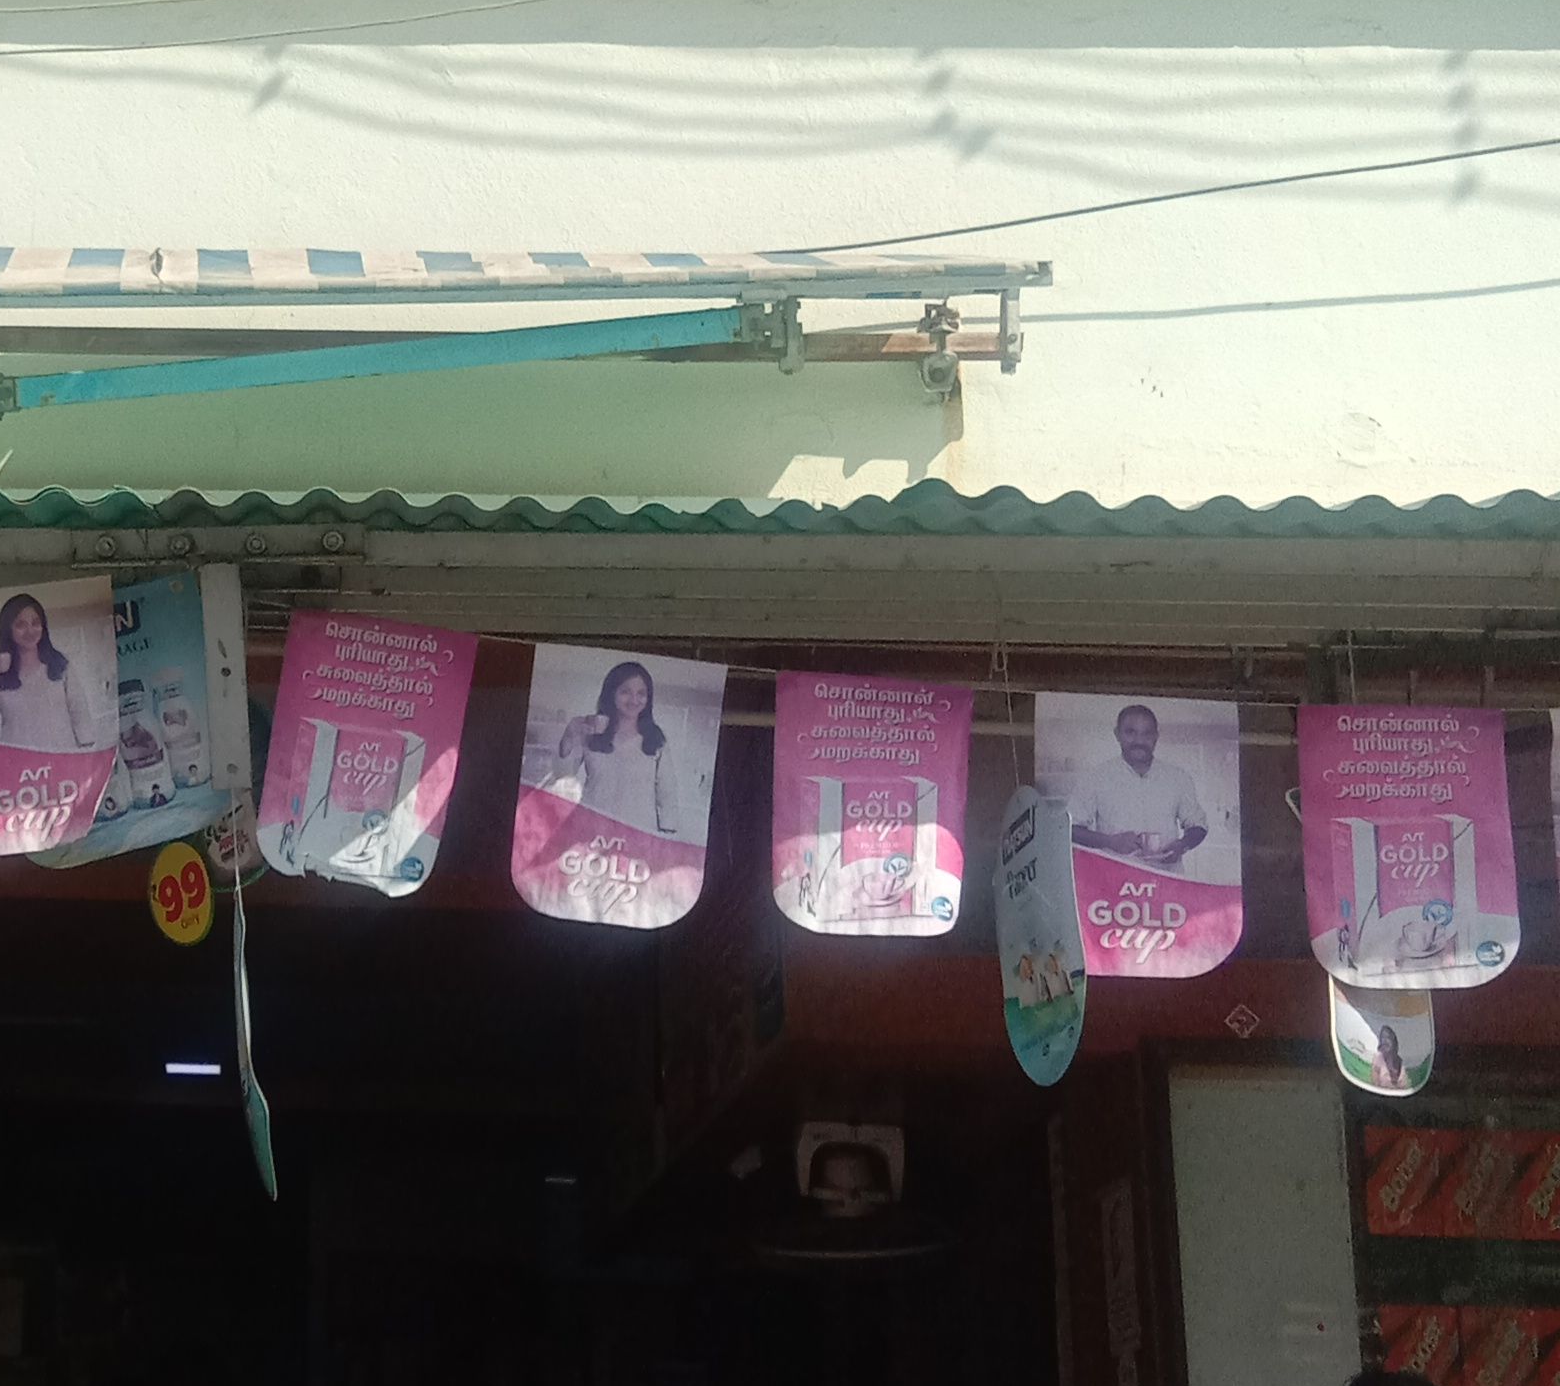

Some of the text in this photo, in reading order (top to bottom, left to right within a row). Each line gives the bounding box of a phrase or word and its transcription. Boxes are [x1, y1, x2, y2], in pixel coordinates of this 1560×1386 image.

[337, 750, 399, 775] GOLD
[846, 799, 913, 818] GOLD
[5, 805, 71, 842] cup
[855, 819, 903, 842] cup
[1379, 842, 1450, 864] GOLD
[559, 849, 651, 884] GOLD
[1118, 881, 1158, 897] AVT
[1087, 899, 1188, 929] GOLD
[1099, 928, 1176, 964] cup
